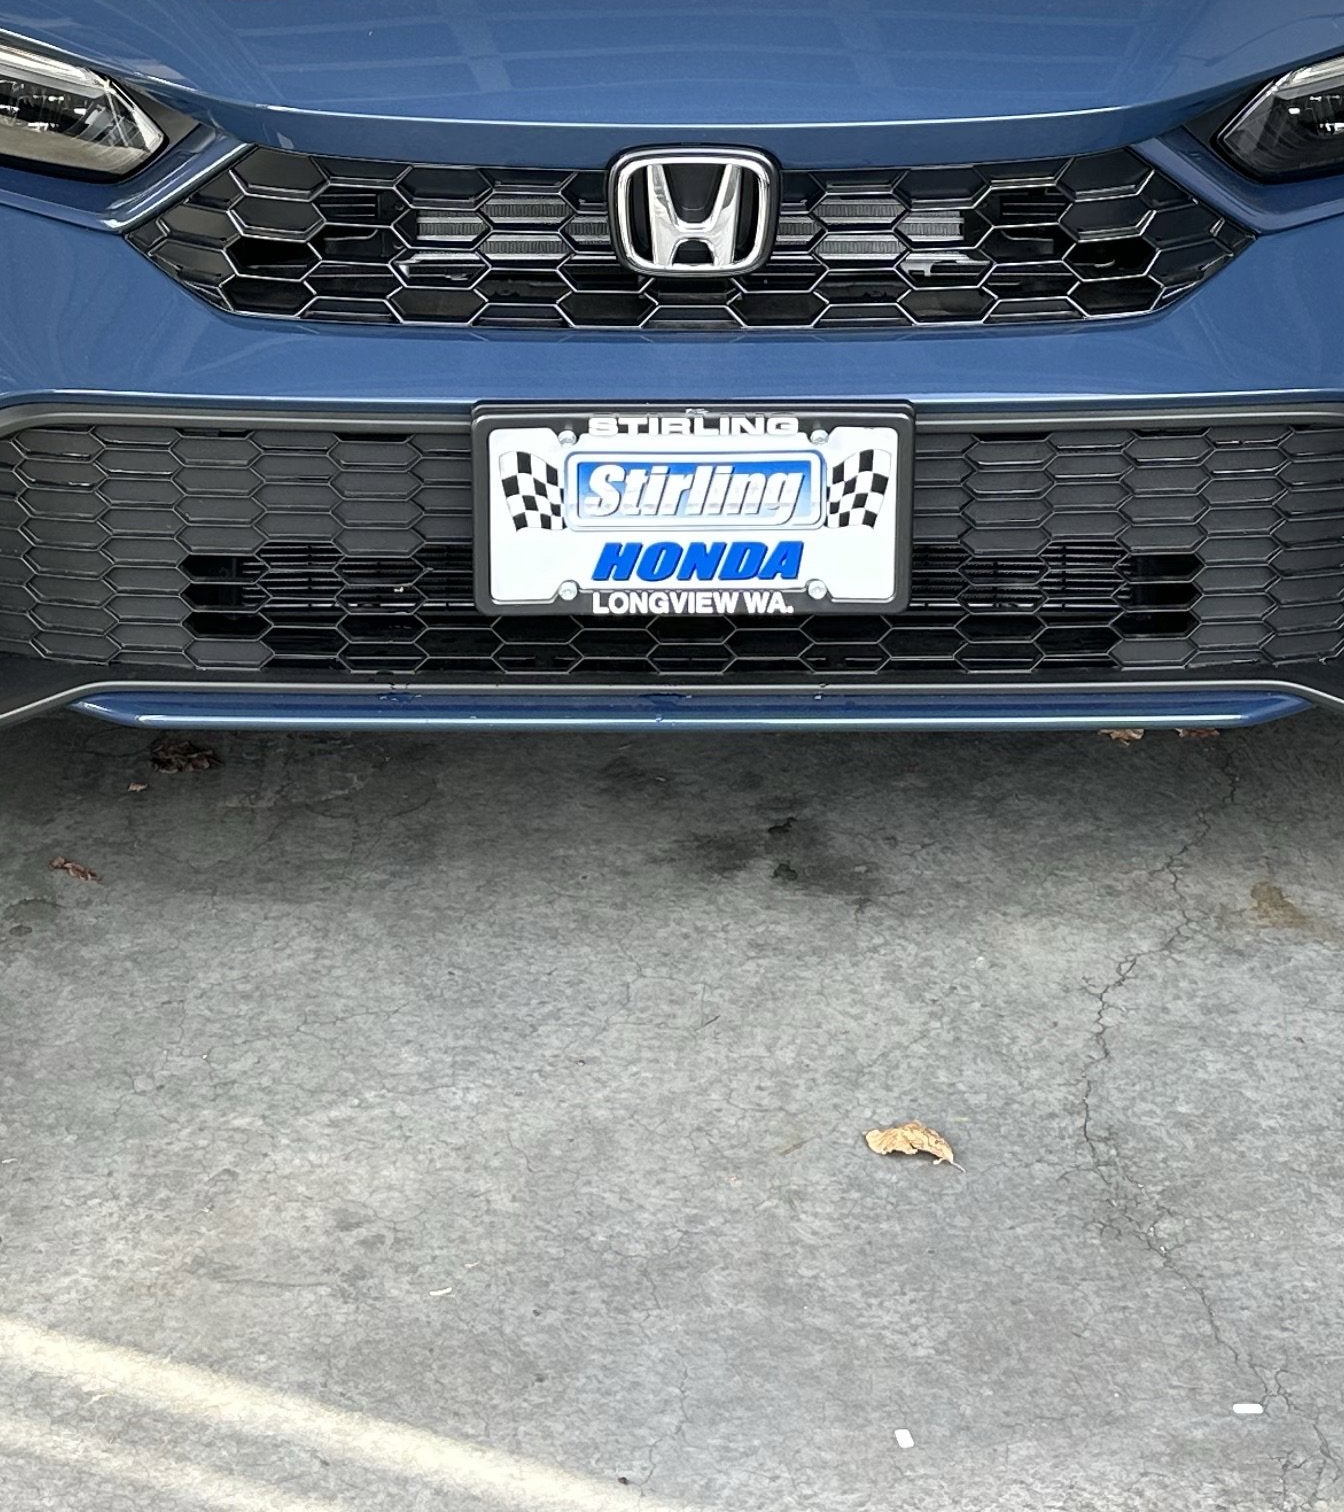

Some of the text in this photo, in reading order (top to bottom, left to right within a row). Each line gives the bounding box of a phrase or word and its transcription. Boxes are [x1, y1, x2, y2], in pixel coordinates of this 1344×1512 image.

[588, 415, 799, 437] STIRLING
[587, 464, 804, 525] Stirling
[592, 541, 804, 581] HONDA
[592, 591, 794, 614] LONGVIEW WA.
